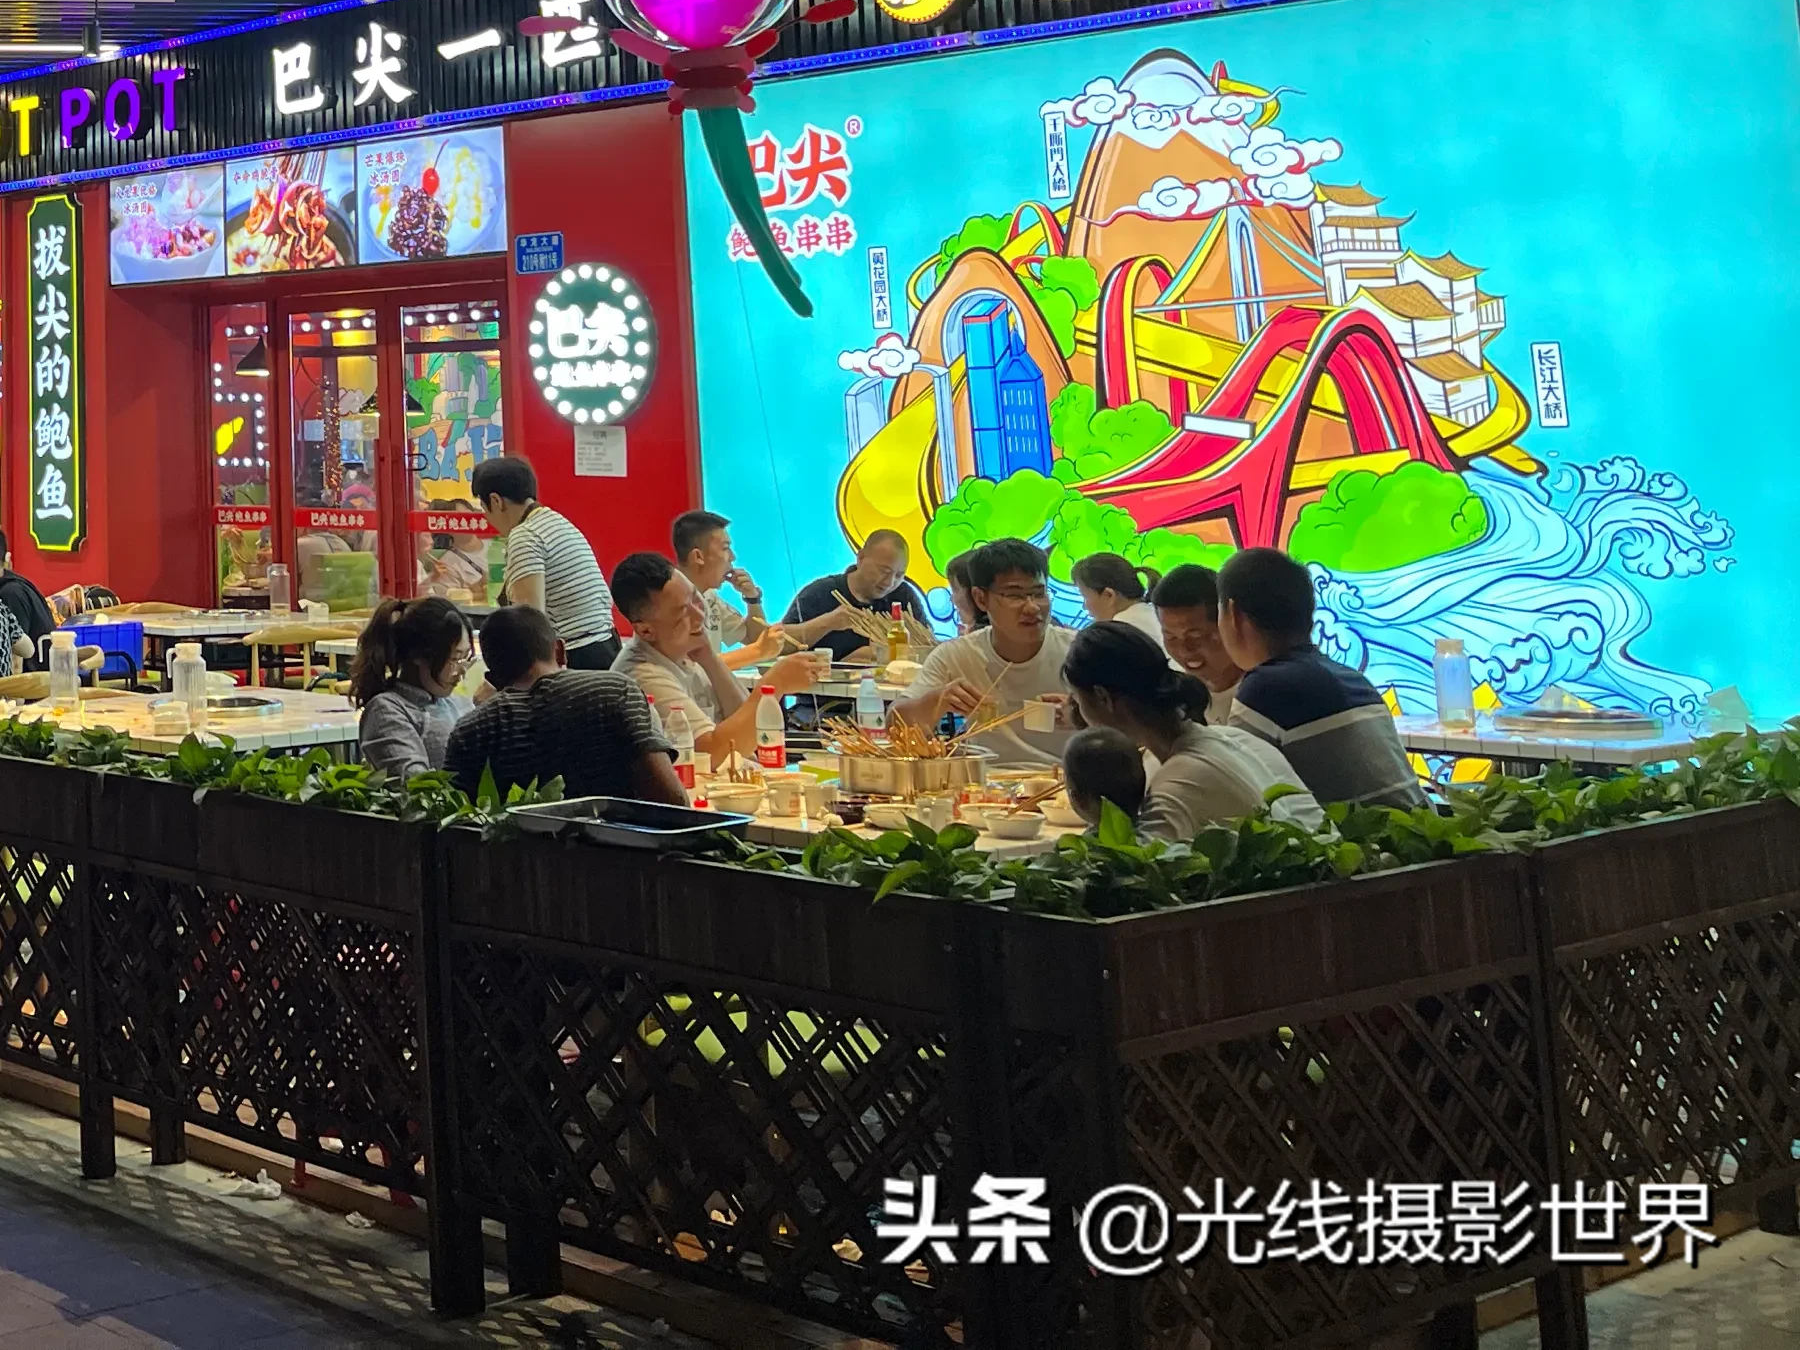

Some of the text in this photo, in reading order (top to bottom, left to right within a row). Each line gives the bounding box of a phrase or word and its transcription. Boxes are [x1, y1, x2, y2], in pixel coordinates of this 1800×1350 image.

[60, 67, 185, 149] POT
[32, 224, 73, 521] 拔尖的鲍鱼
[1538, 349, 1563, 419] 长江大桥
